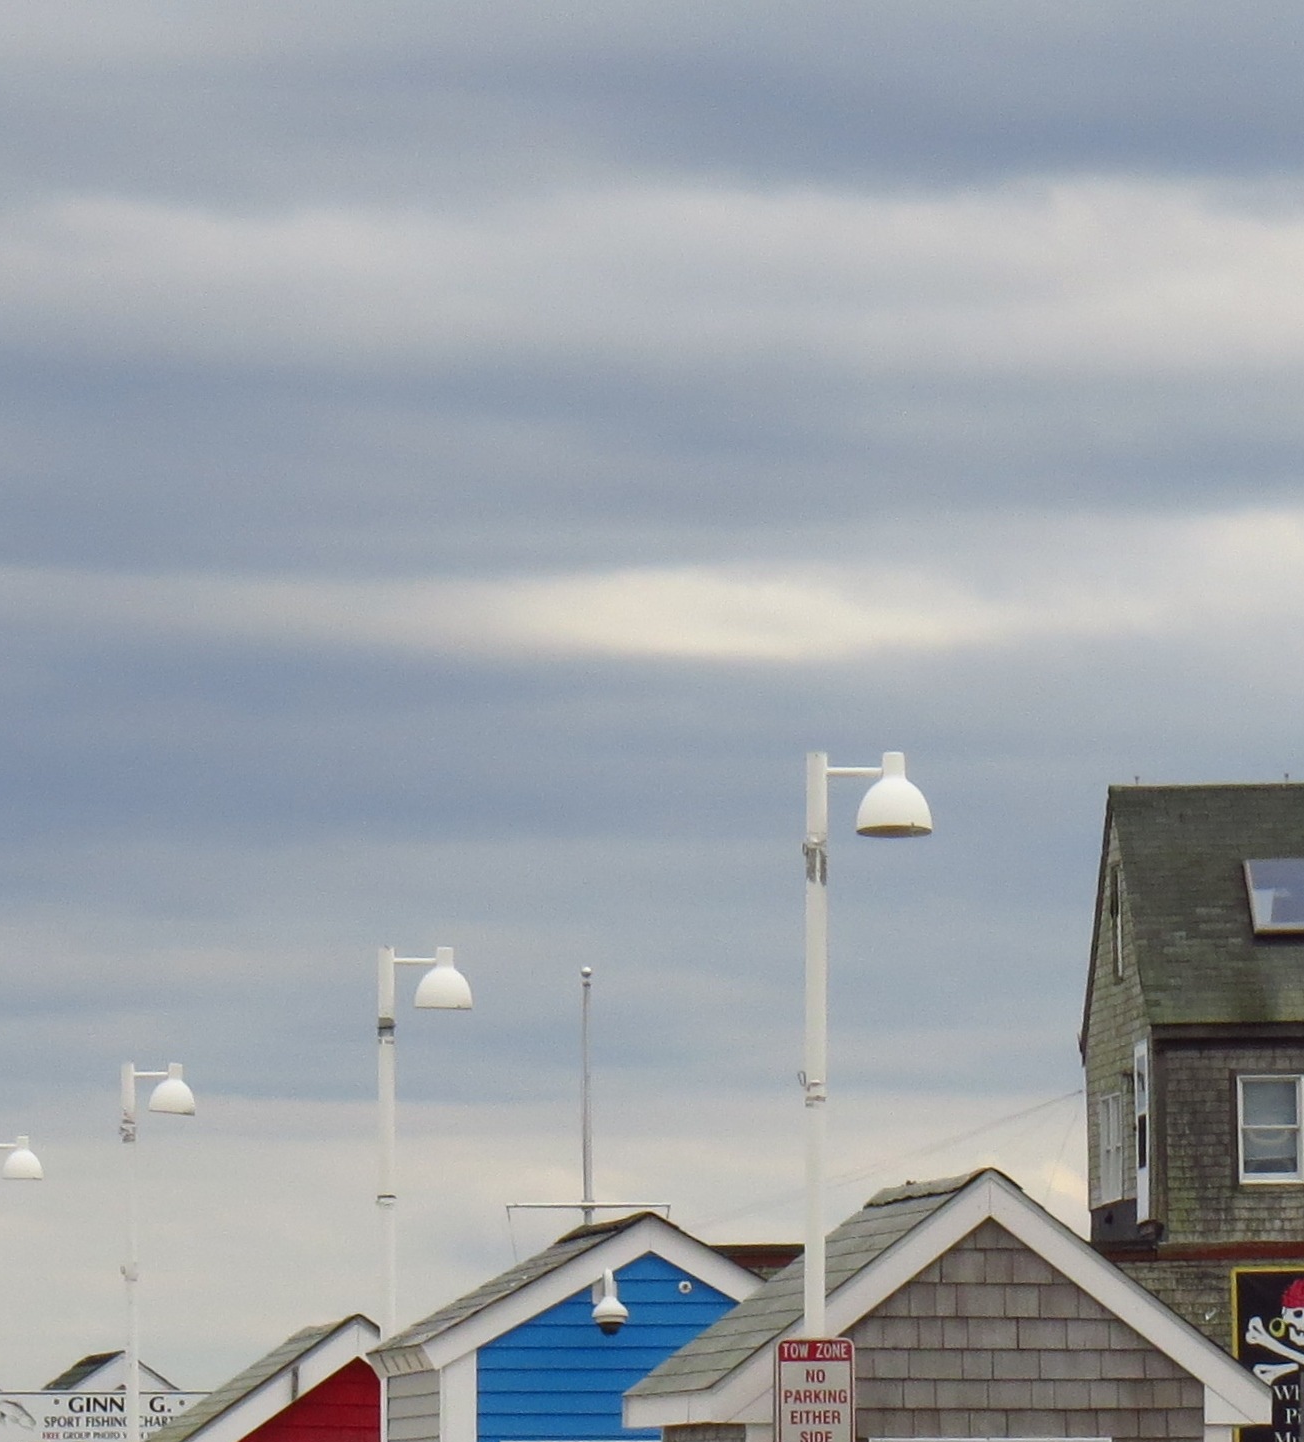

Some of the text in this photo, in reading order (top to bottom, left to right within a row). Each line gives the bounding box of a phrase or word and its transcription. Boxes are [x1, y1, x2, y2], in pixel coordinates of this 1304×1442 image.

[782, 1344, 848, 1358] TOW ZONE
[805, 1369, 826, 1383] NO
[783, 1390, 848, 1404] PARKING
[68, 1396, 172, 1413] GINN G.
[44, 1416, 81, 1428] SPORT
[790, 1411, 841, 1425] EITHER
[63, 1431, 91, 1440] GROUP
